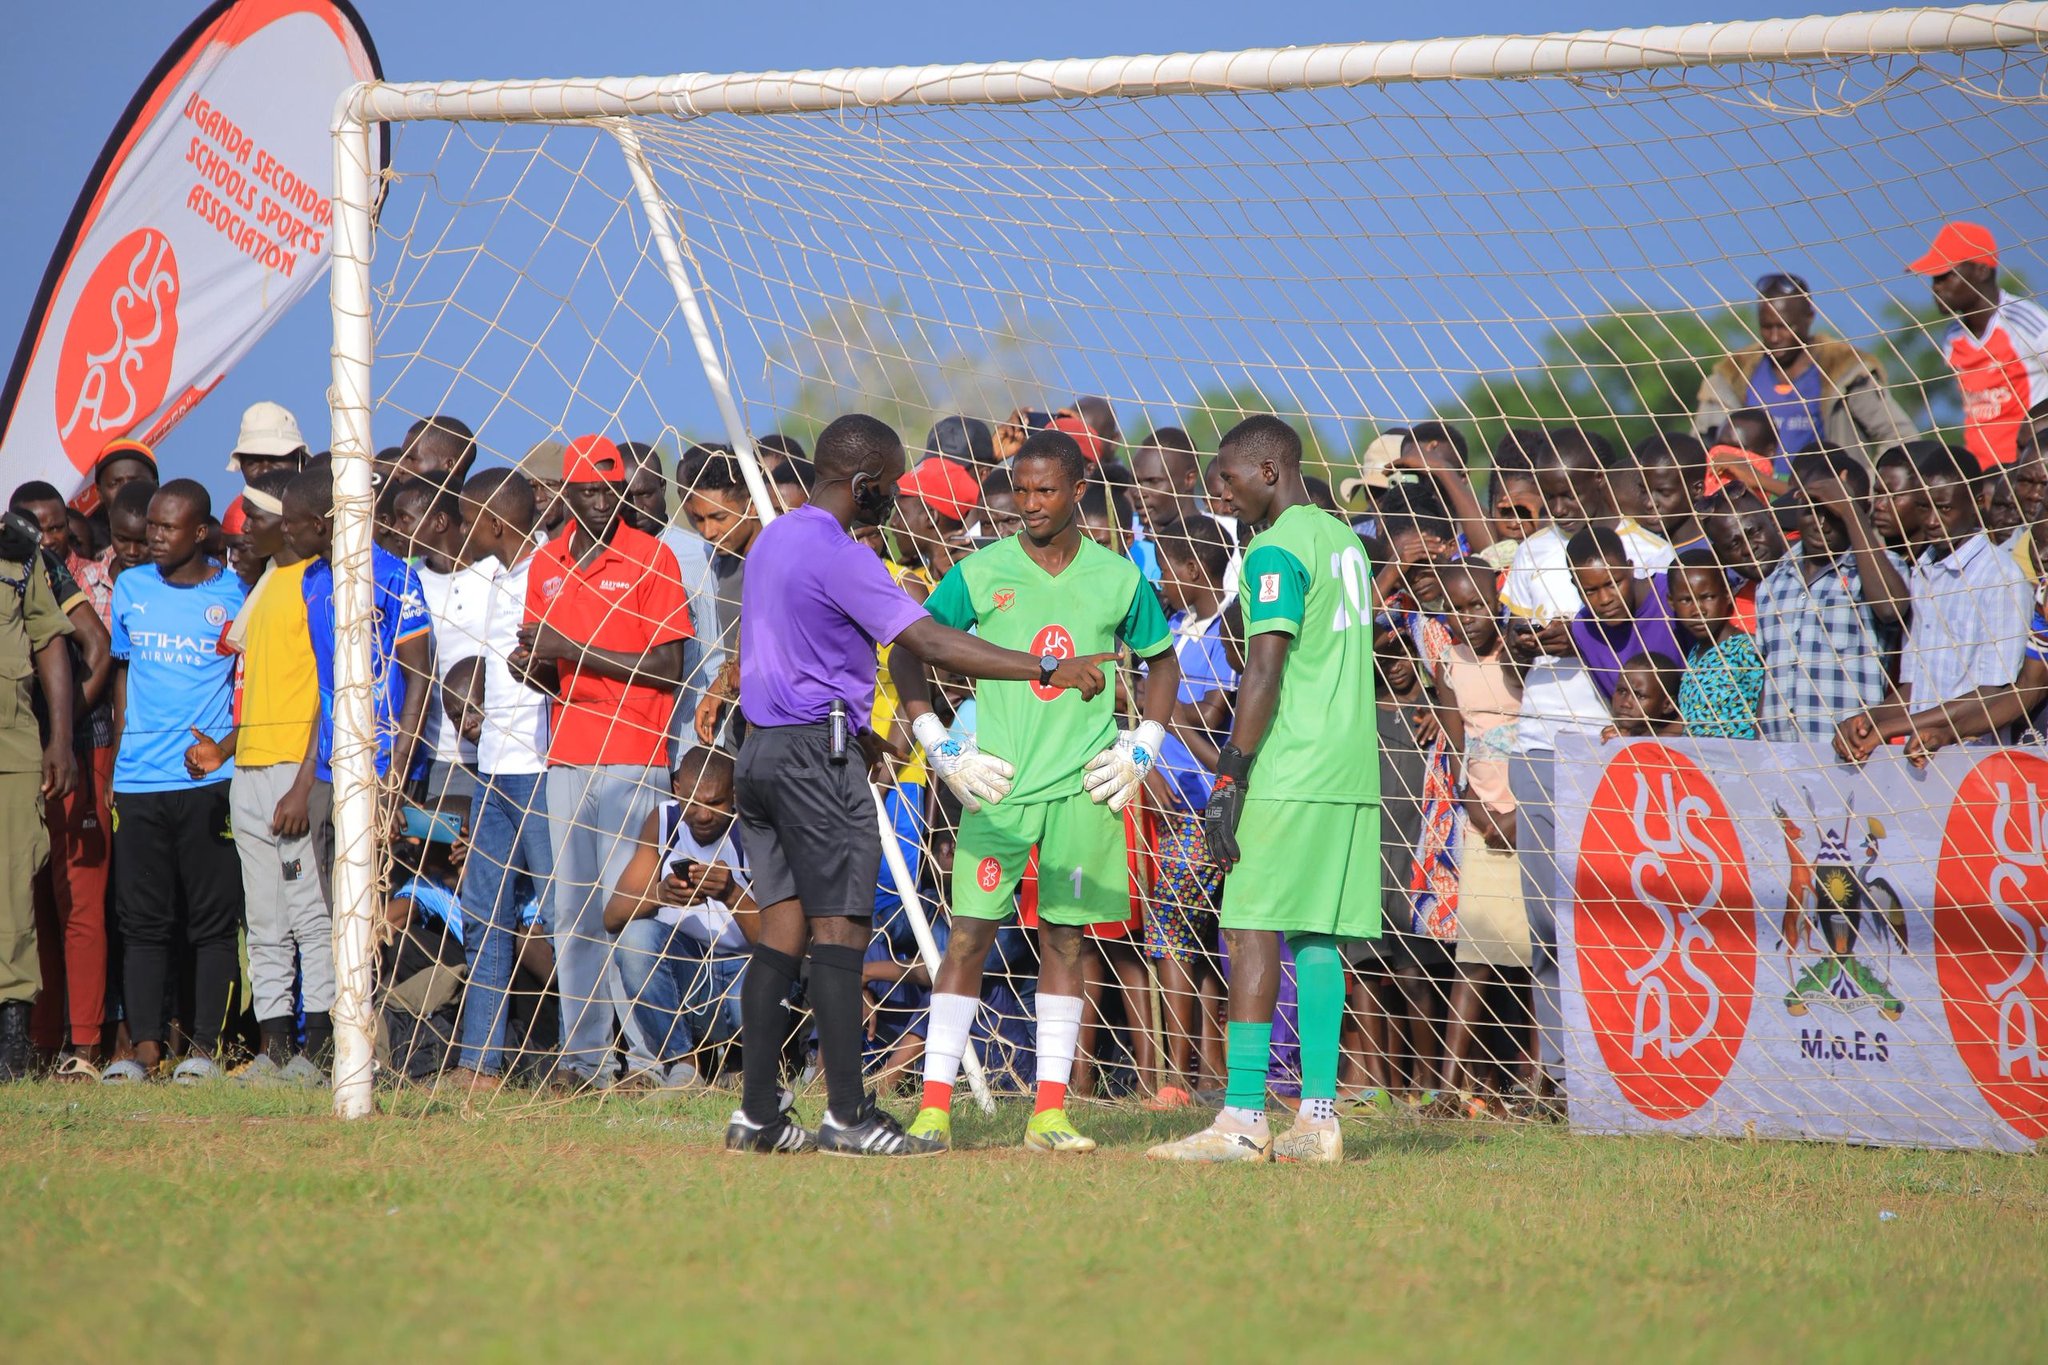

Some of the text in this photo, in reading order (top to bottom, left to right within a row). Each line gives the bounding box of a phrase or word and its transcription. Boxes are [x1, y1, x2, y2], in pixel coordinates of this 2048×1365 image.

[184, 91, 333, 227] UGANDA SECONDA
[185, 136, 325, 255] SCHOOLS SPORTS
[186, 183, 298, 278] ASSOCIATION
[130, 631, 217, 654] ETIHAD
[141, 651, 201, 667] AIRWAYS
[1068, 866, 1083, 899] 1
